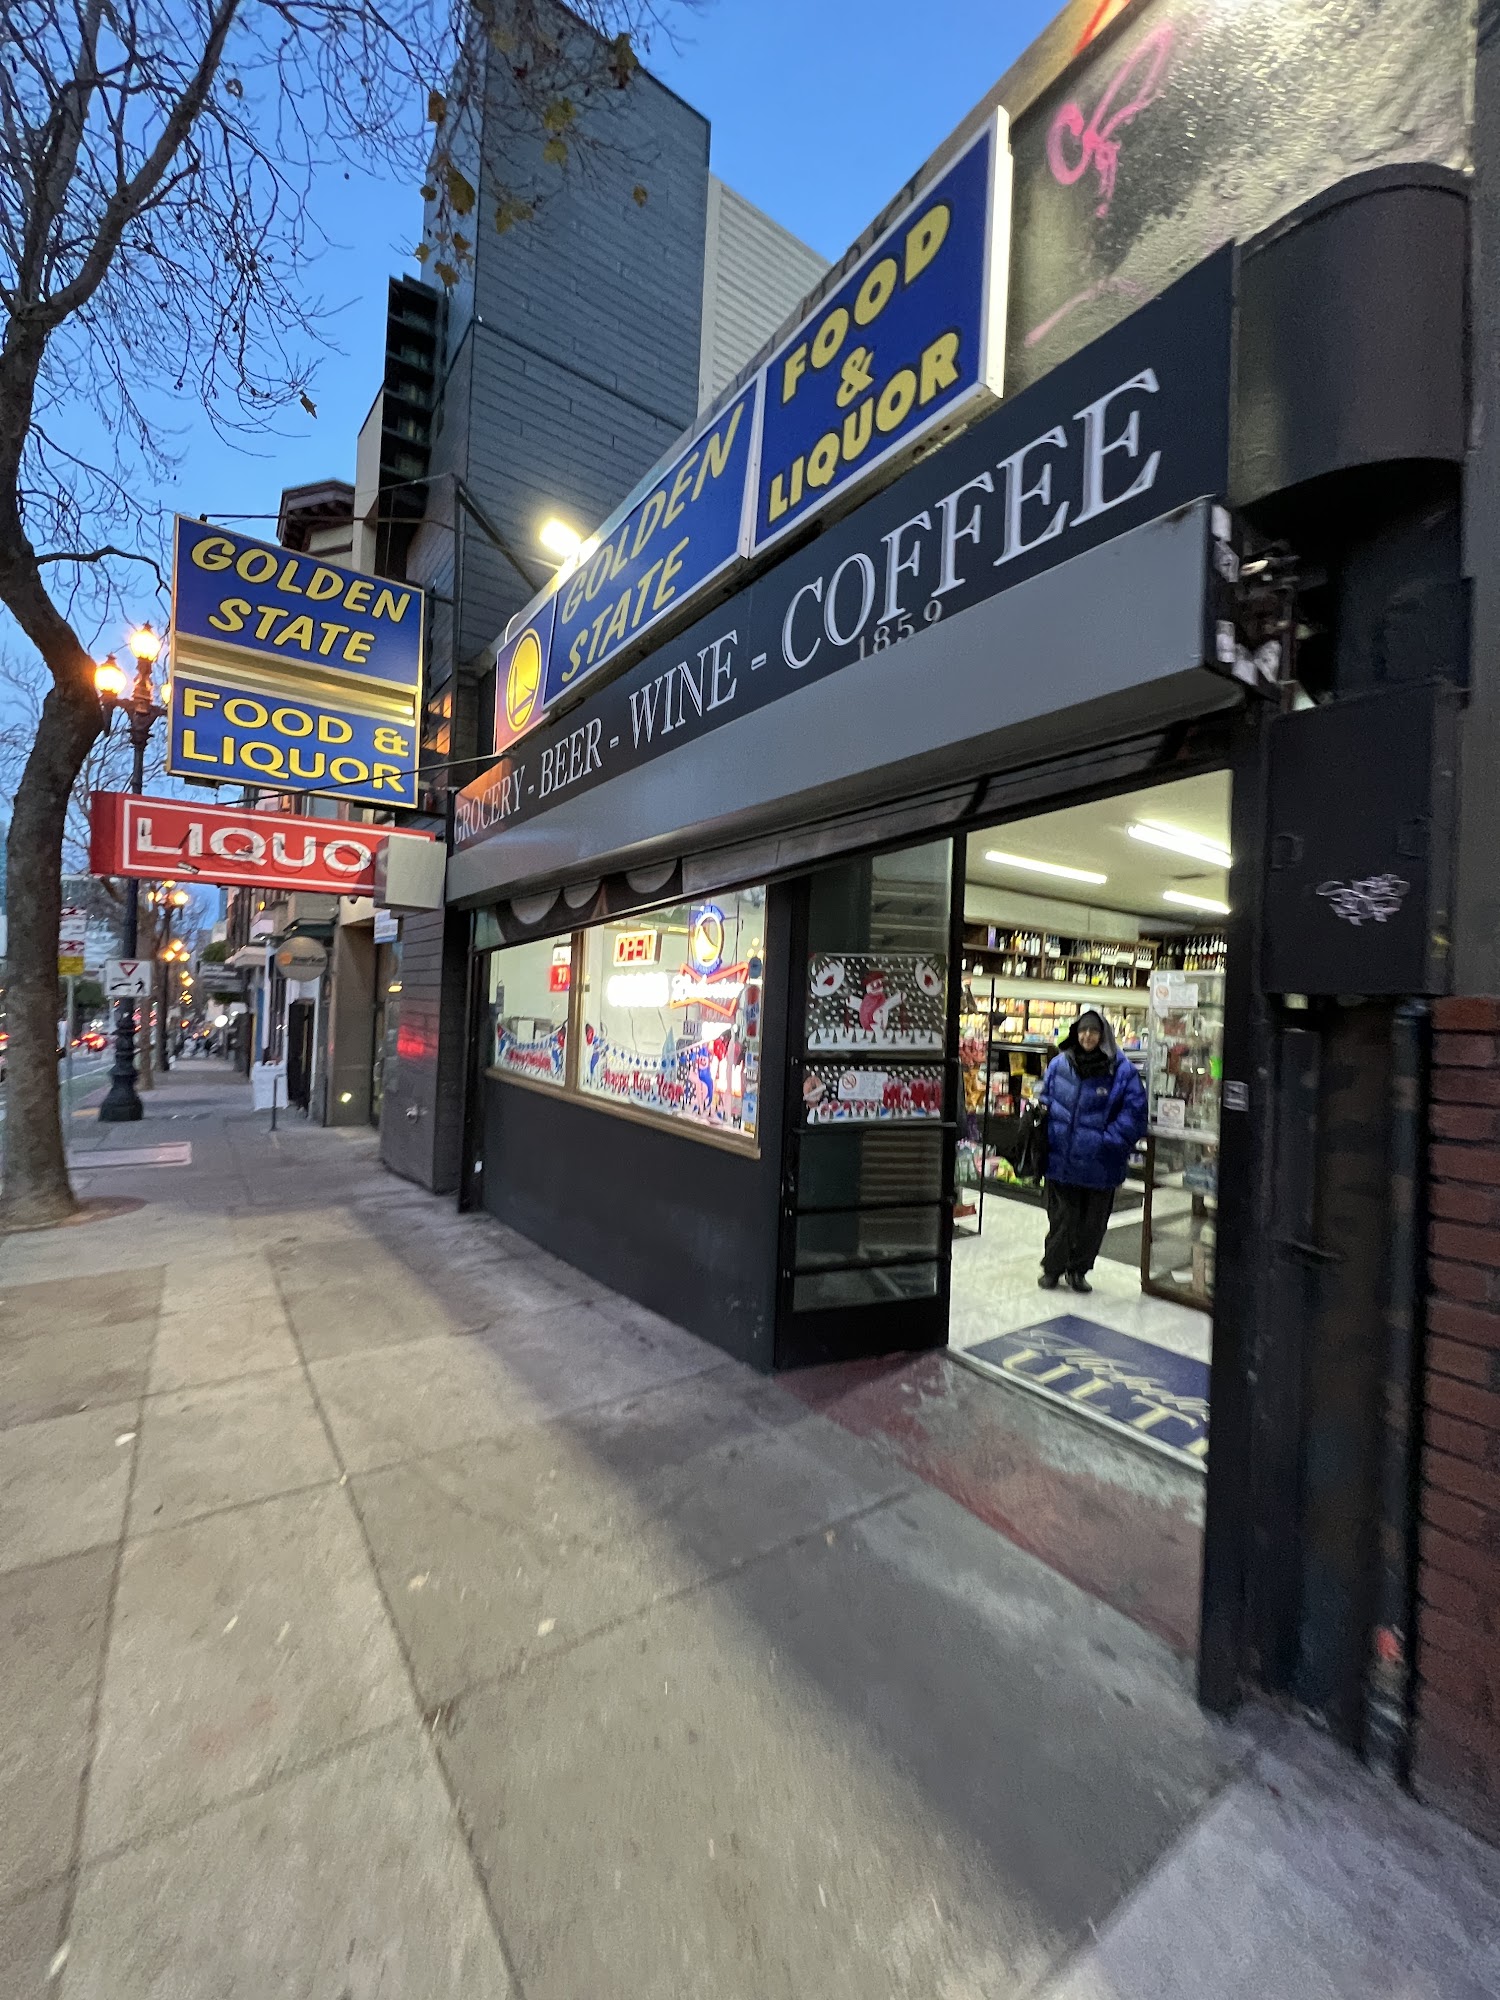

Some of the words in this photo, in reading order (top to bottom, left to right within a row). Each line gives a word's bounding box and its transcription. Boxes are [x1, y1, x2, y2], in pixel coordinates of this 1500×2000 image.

[782, 204, 950, 404] FOOD
[836, 346, 874, 407] &
[769, 332, 960, 522] LIQUOR
[561, 402, 744, 625] GOLDEN
[191, 537, 411, 622] GOLDEN
[454, 765, 526, 845] GROCERY
[538, 717, 603, 799] BEER
[628, 629, 738, 749] WINE
[782, 367, 1162, 669] COFFEE
[561, 536, 690, 682] STATE
[208, 597, 375, 663] STATE
[860, 600, 942, 660] 1859
[183, 687, 353, 744] FOOD
[373, 727, 409, 757] &
[182, 729, 406, 793] LIQUOR
[137, 817, 372, 873] LIQUO
[616, 935, 655, 962] OPEN
